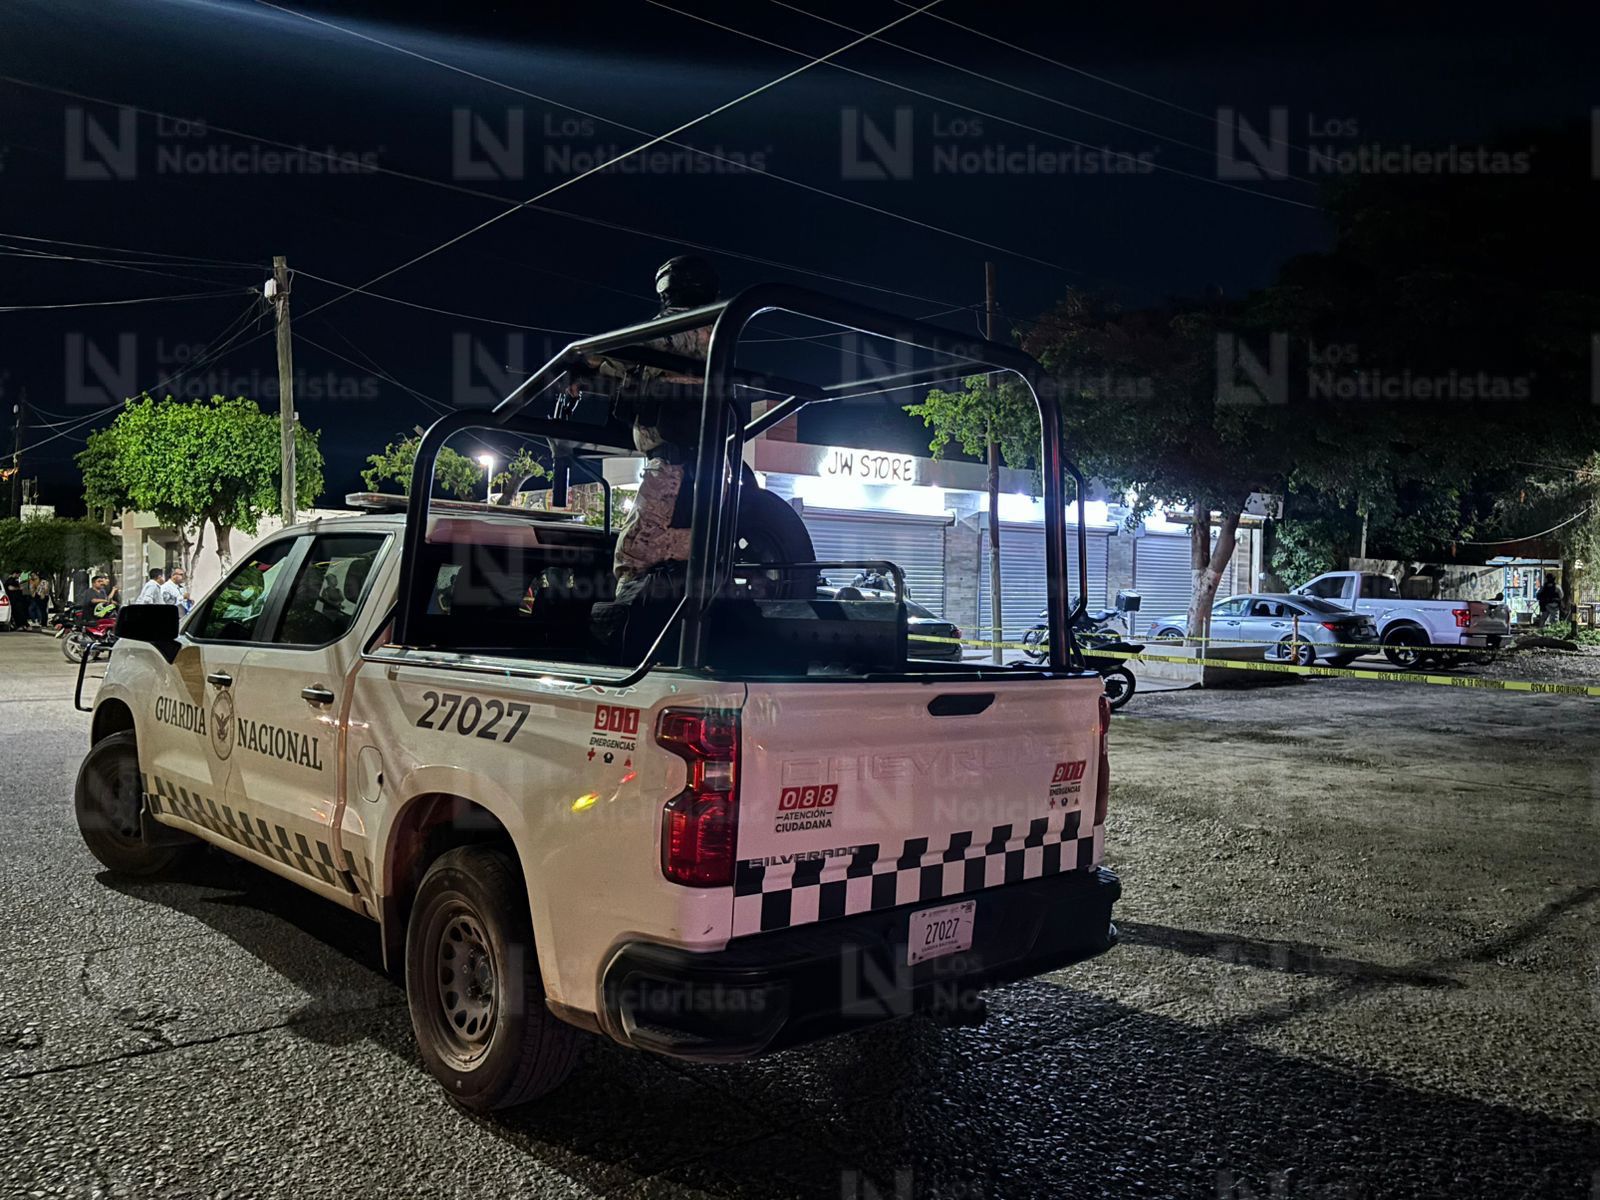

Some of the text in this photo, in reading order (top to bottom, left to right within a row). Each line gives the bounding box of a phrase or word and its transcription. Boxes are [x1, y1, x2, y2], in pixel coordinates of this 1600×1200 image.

[828, 451, 912, 481] JW STORE
[416, 691, 530, 743] 27027
[597, 707, 638, 732] 911
[155, 696, 322, 771] GUARDIA NACIONAL
[590, 737, 636, 751] EMERGENCIAS
[1054, 762, 1085, 782] 911
[780, 785, 836, 810] 088
[775, 819, 832, 833] CIUDADANA
[749, 847, 859, 869] SILVERADO
[925, 918, 960, 945] 27027
